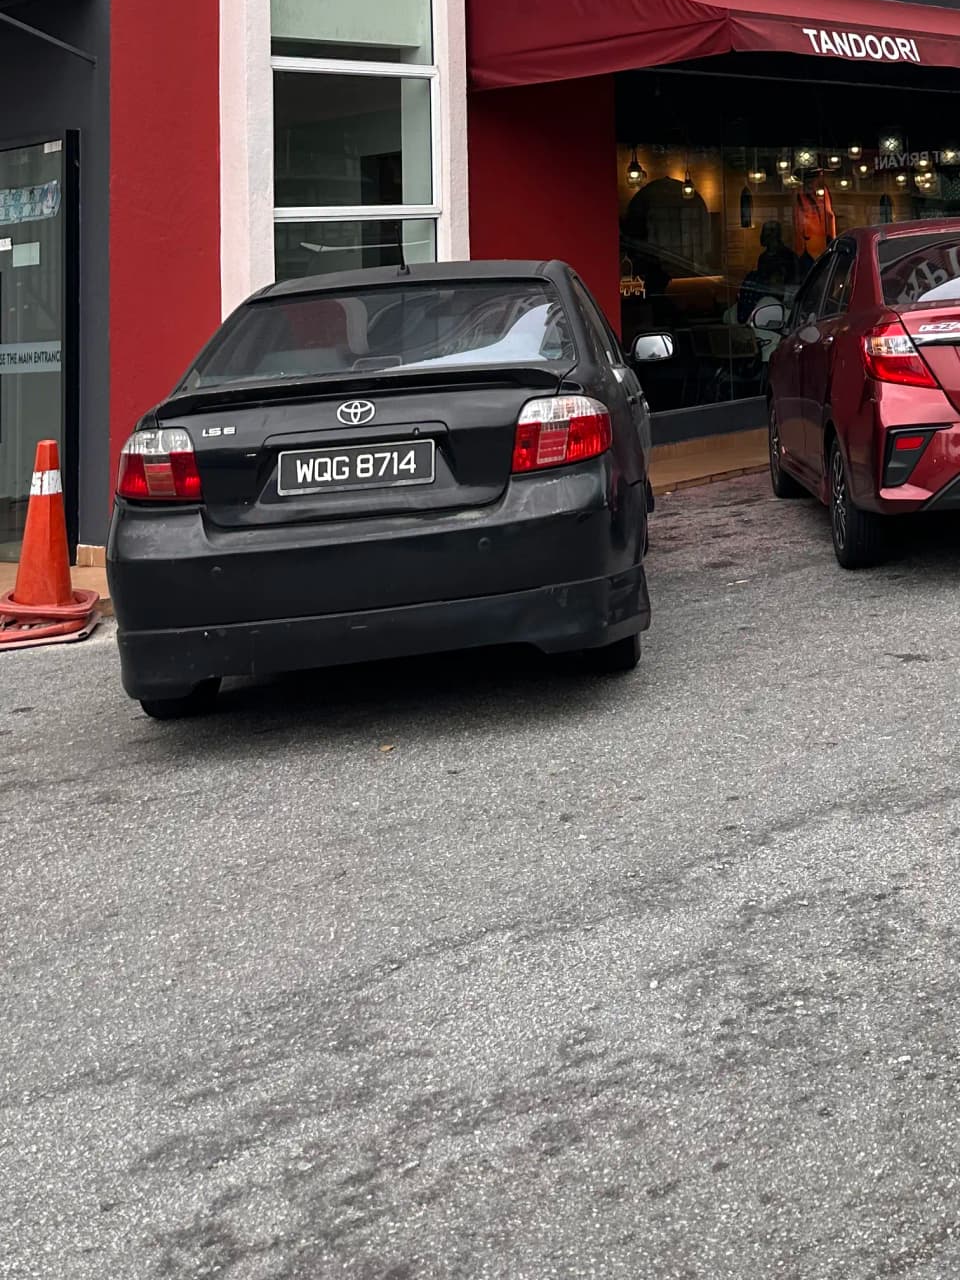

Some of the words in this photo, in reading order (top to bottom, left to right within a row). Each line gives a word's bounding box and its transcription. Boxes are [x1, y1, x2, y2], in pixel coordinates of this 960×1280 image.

[803, 28, 920, 63] TANDOORI
[296, 456, 350, 484] WQG
[356, 450, 417, 478] 8714
